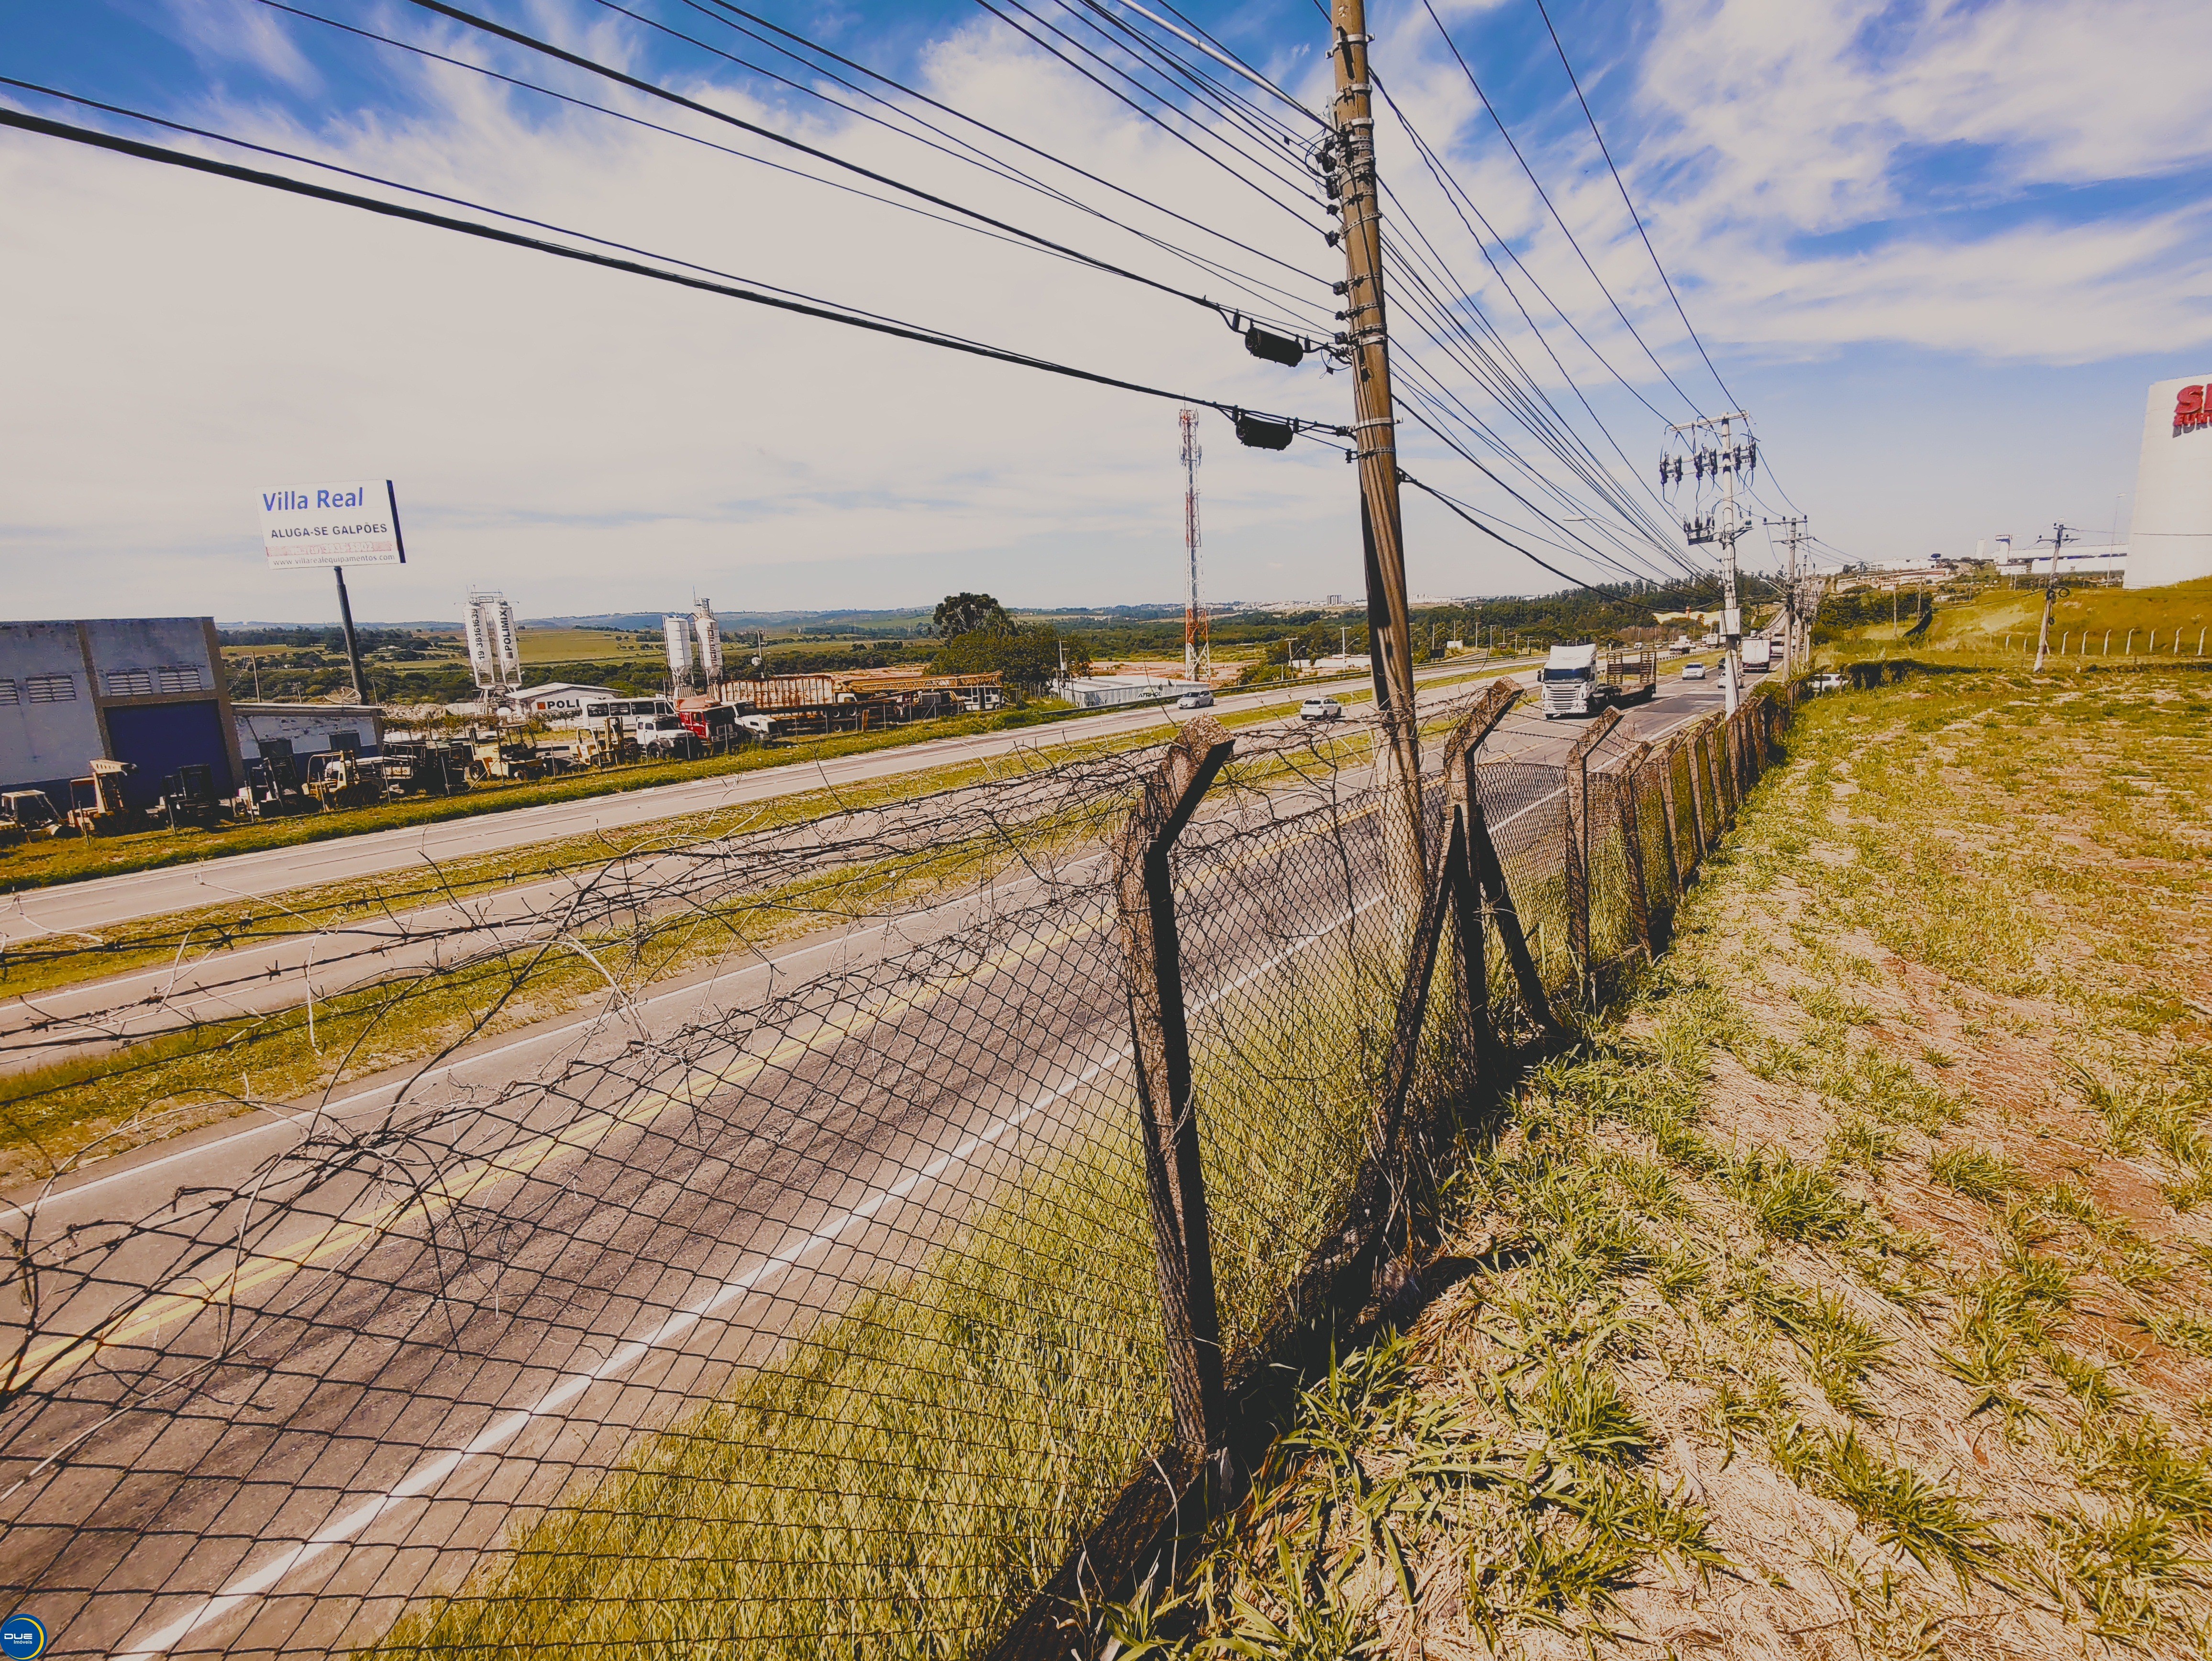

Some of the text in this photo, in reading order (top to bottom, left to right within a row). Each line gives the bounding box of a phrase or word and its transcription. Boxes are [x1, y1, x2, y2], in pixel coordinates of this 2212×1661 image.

[263, 487, 363, 511] Villa Real
[271, 522, 387, 538] ALUGA-SE GALPÕES
[273, 554, 395, 565] www.villarealequipamentos.com
[499, 609, 513, 651] POLIMIX
[547, 699, 580, 709] POLI
